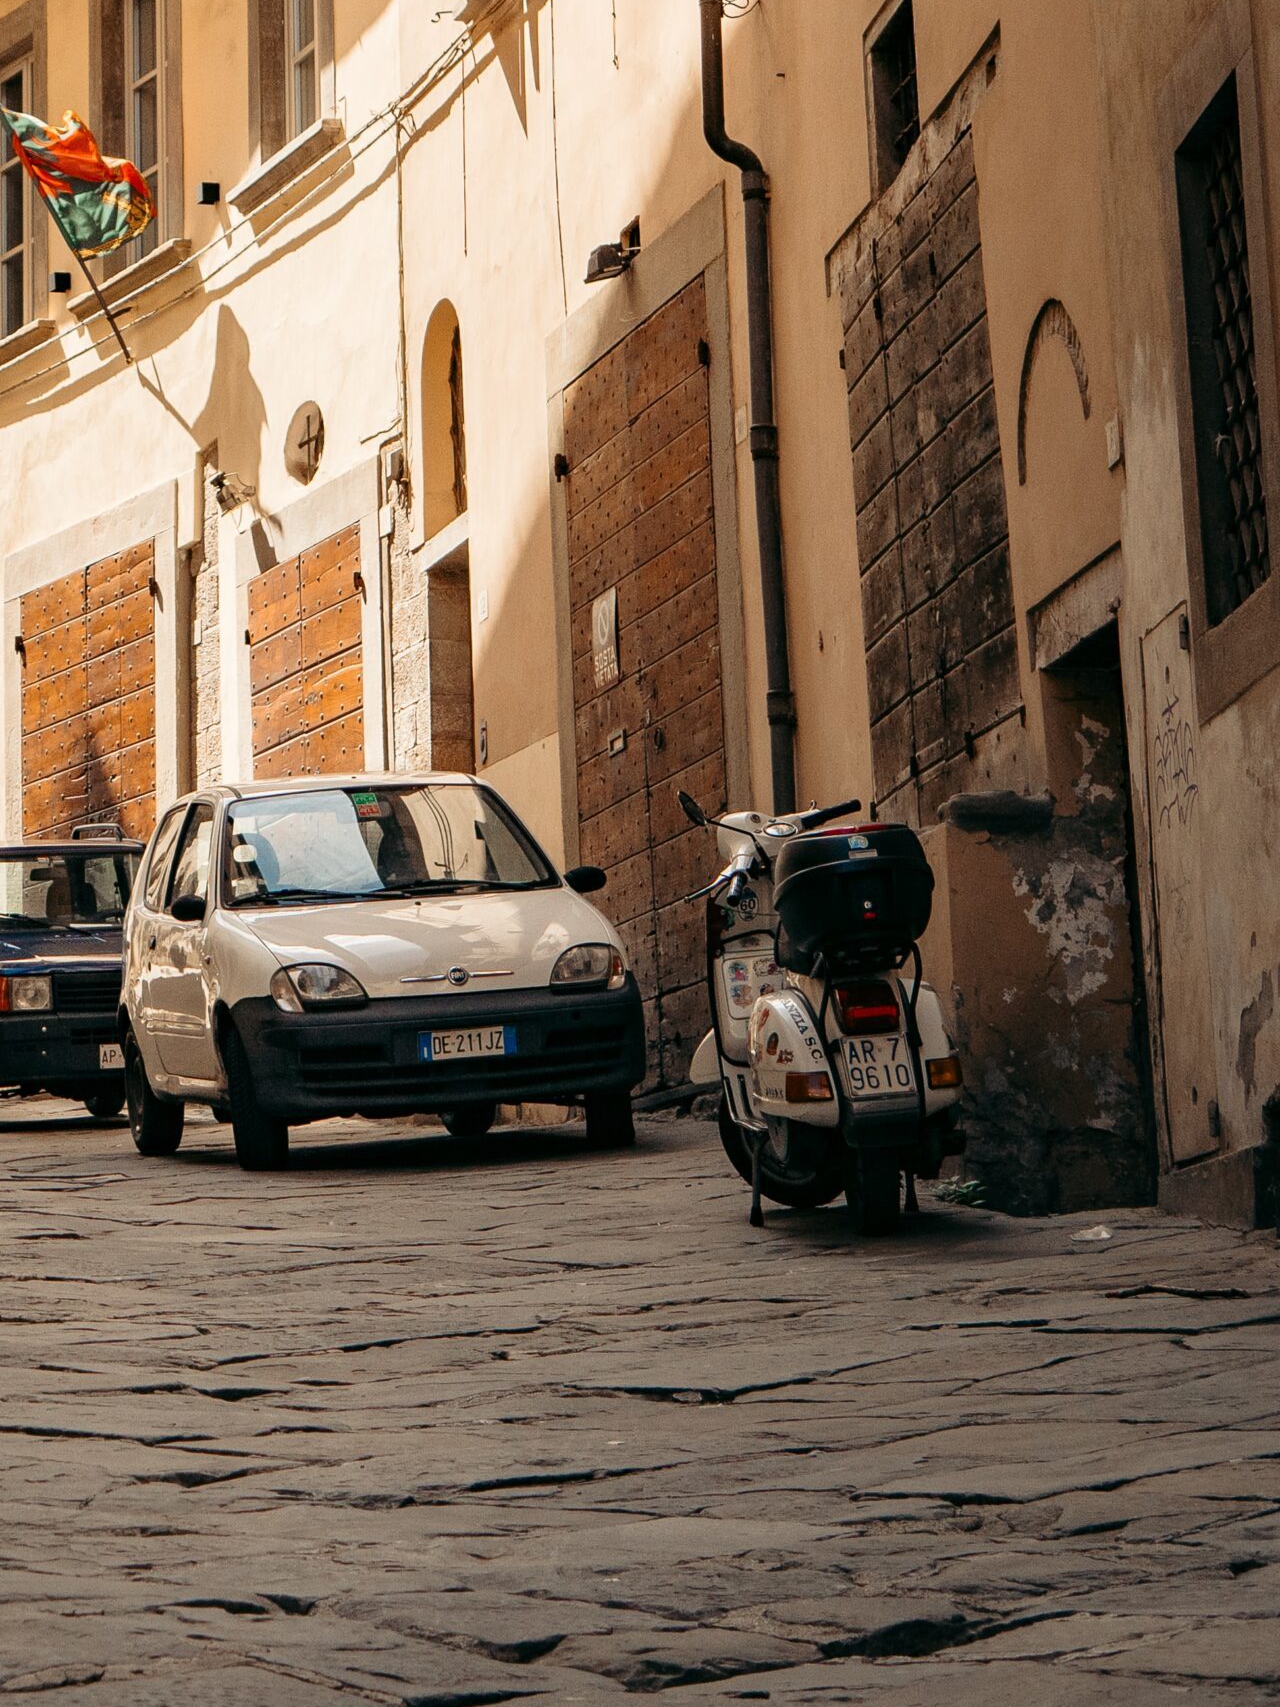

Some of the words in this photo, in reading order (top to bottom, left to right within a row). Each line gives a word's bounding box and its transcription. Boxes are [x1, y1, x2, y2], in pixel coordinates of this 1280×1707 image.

[594, 645, 617, 673] SOSTA
[740, 898, 756, 912] 60
[848, 1039, 877, 1064] AR
[886, 1037, 900, 1062] 7
[850, 1063, 910, 1091] 9610
